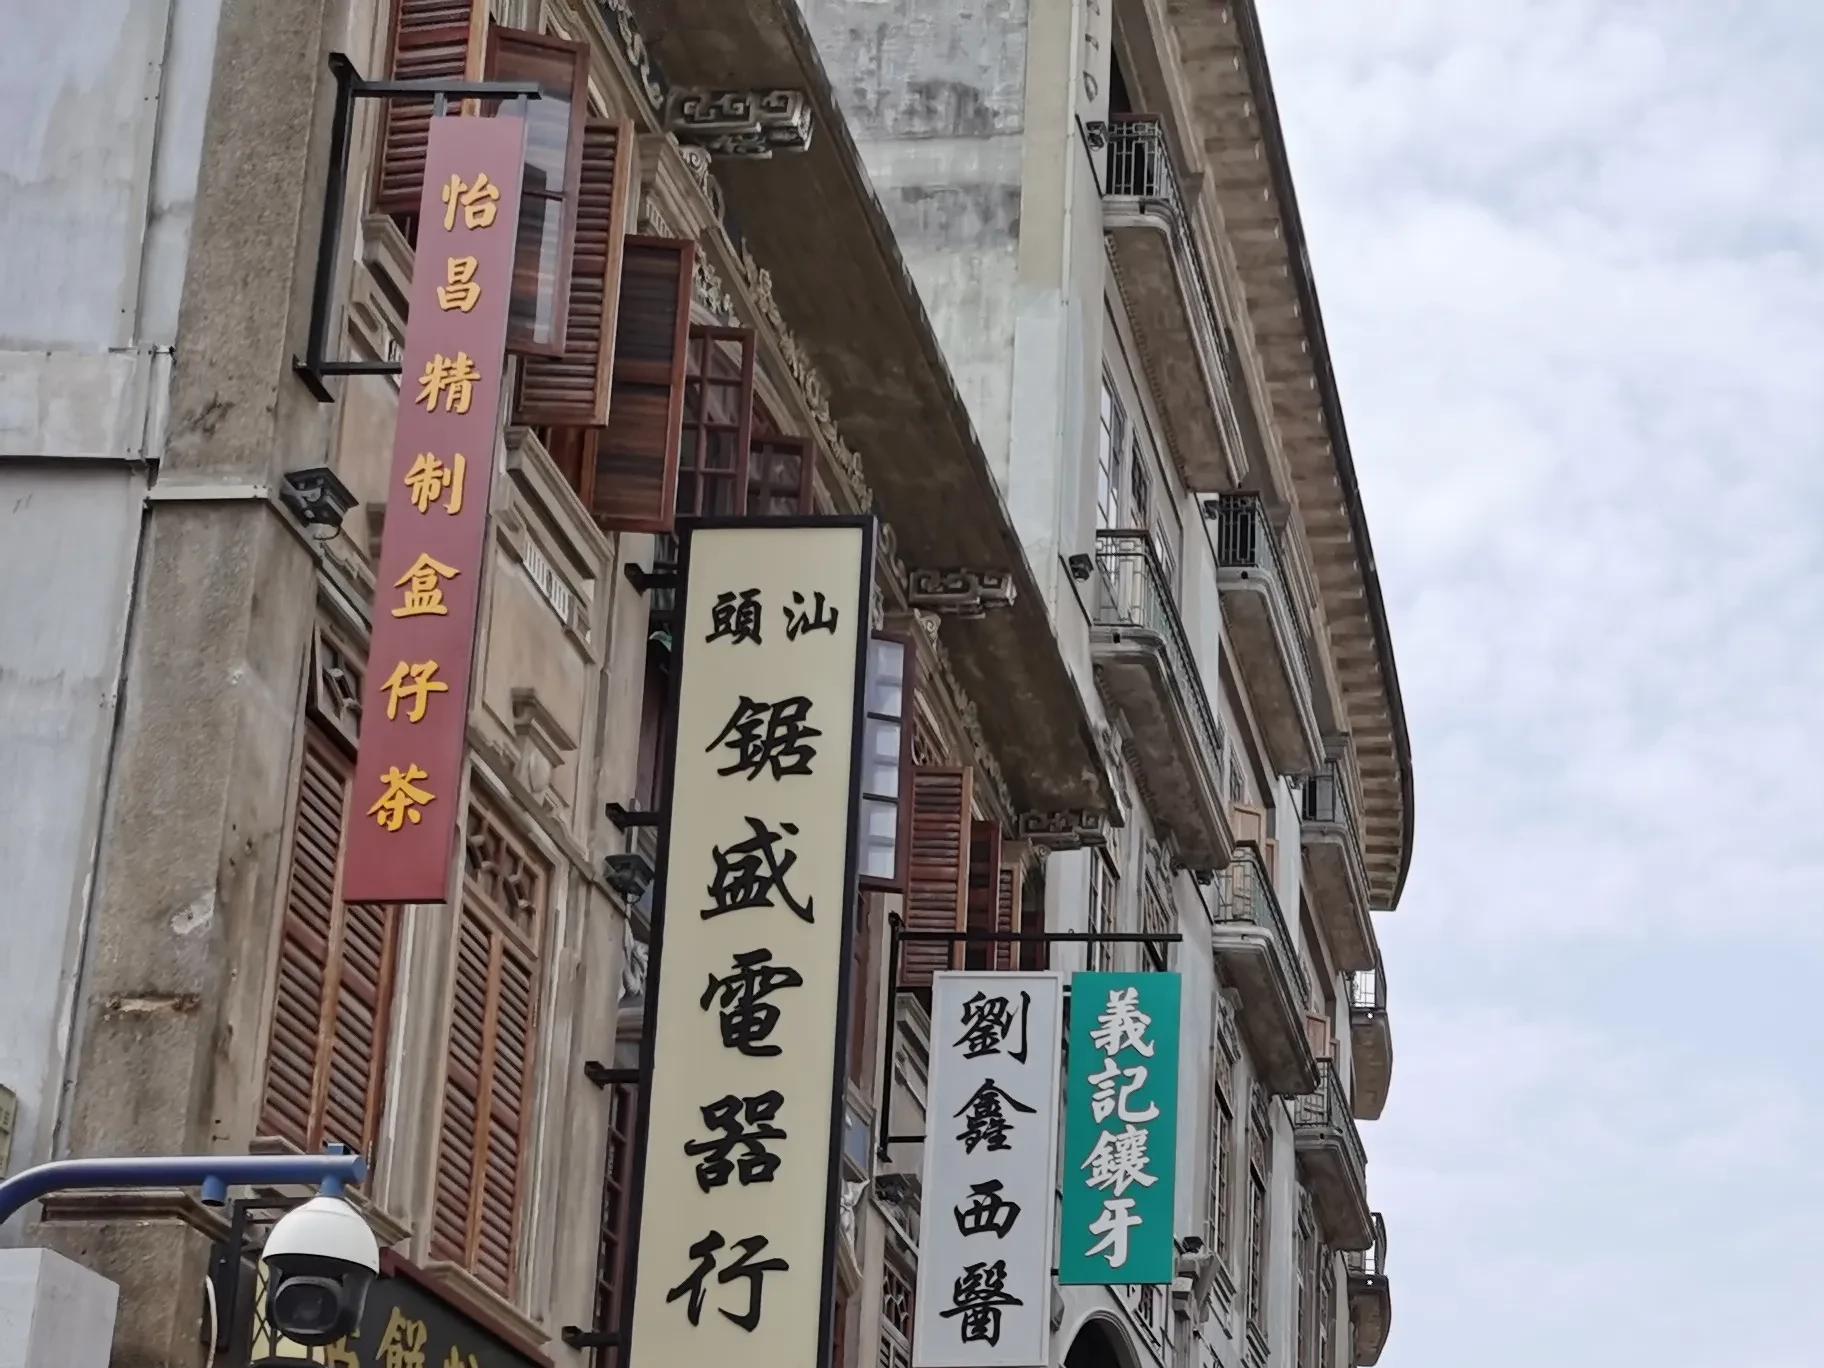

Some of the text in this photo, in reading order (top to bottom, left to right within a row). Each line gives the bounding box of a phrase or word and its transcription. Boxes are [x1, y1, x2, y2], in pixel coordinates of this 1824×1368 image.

[367, 172, 501, 832] 怡昌精制盒仔茶
[666, 694, 823, 1333] 鋸盛電器行
[939, 989, 1037, 1348] 劉鑫西醫
[1080, 989, 1161, 1269] 義記鑲牙
